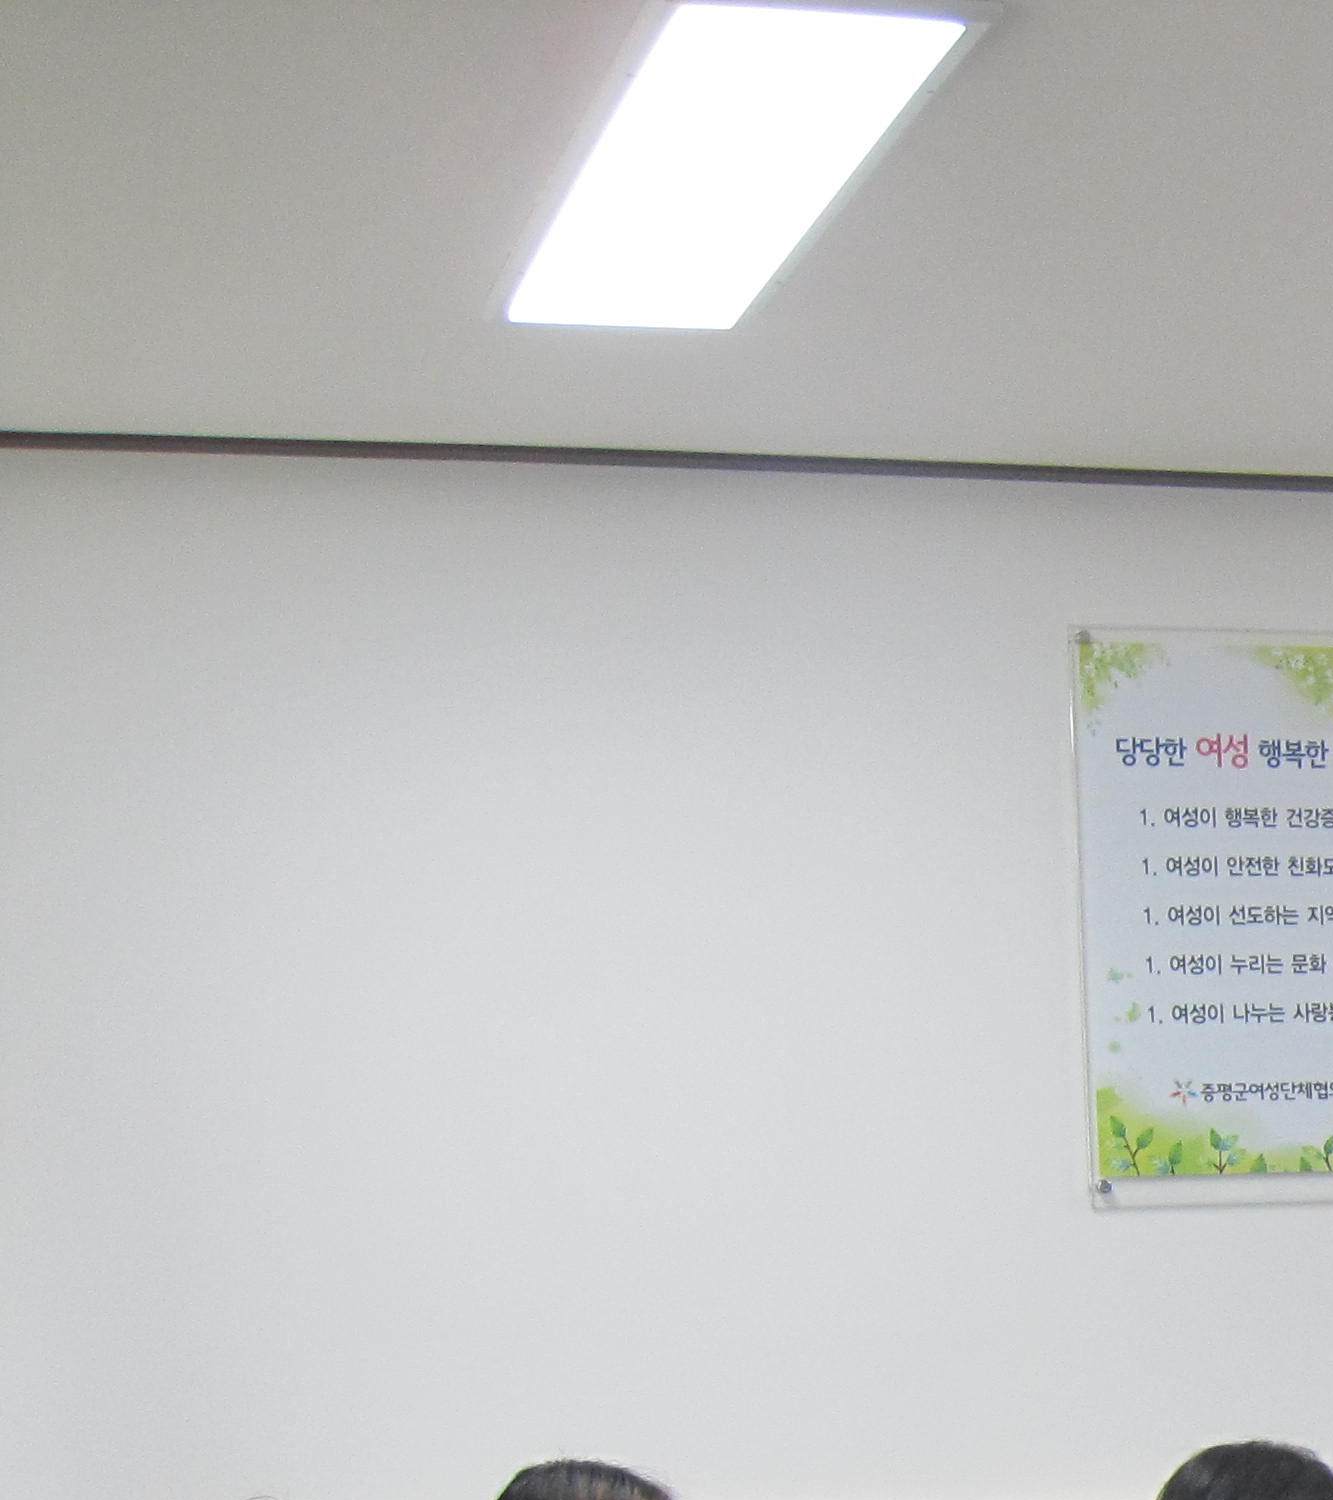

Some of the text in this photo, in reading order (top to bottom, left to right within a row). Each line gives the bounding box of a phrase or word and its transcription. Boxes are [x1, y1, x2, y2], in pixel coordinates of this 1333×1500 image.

[1115, 736, 1187, 767] 당당한
[1195, 733, 1249, 769] 여성
[1258, 739, 1329, 769] 행복한
[1139, 808, 1155, 827] 1.
[1163, 807, 1216, 828] 여성이
[1224, 807, 1277, 828] 행복한
[1141, 858, 1157, 876] 1.
[1165, 856, 1218, 877] 여성이
[1226, 856, 1280, 877] 안전한
[1143, 907, 1159, 925] 1.
[1167, 905, 1220, 926] 여성이
[1228, 905, 1299, 926] 선도하는
[1145, 956, 1161, 974] 1.
[1169, 954, 1222, 975] 여성이
[1229, 954, 1283, 975] 누리는
[1290, 954, 1327, 975] 문화
[1147, 1005, 1163, 1024] 1.
[1171, 1003, 1224, 1024] 여성이
[1232, 1003, 1285, 1024] 나누는
